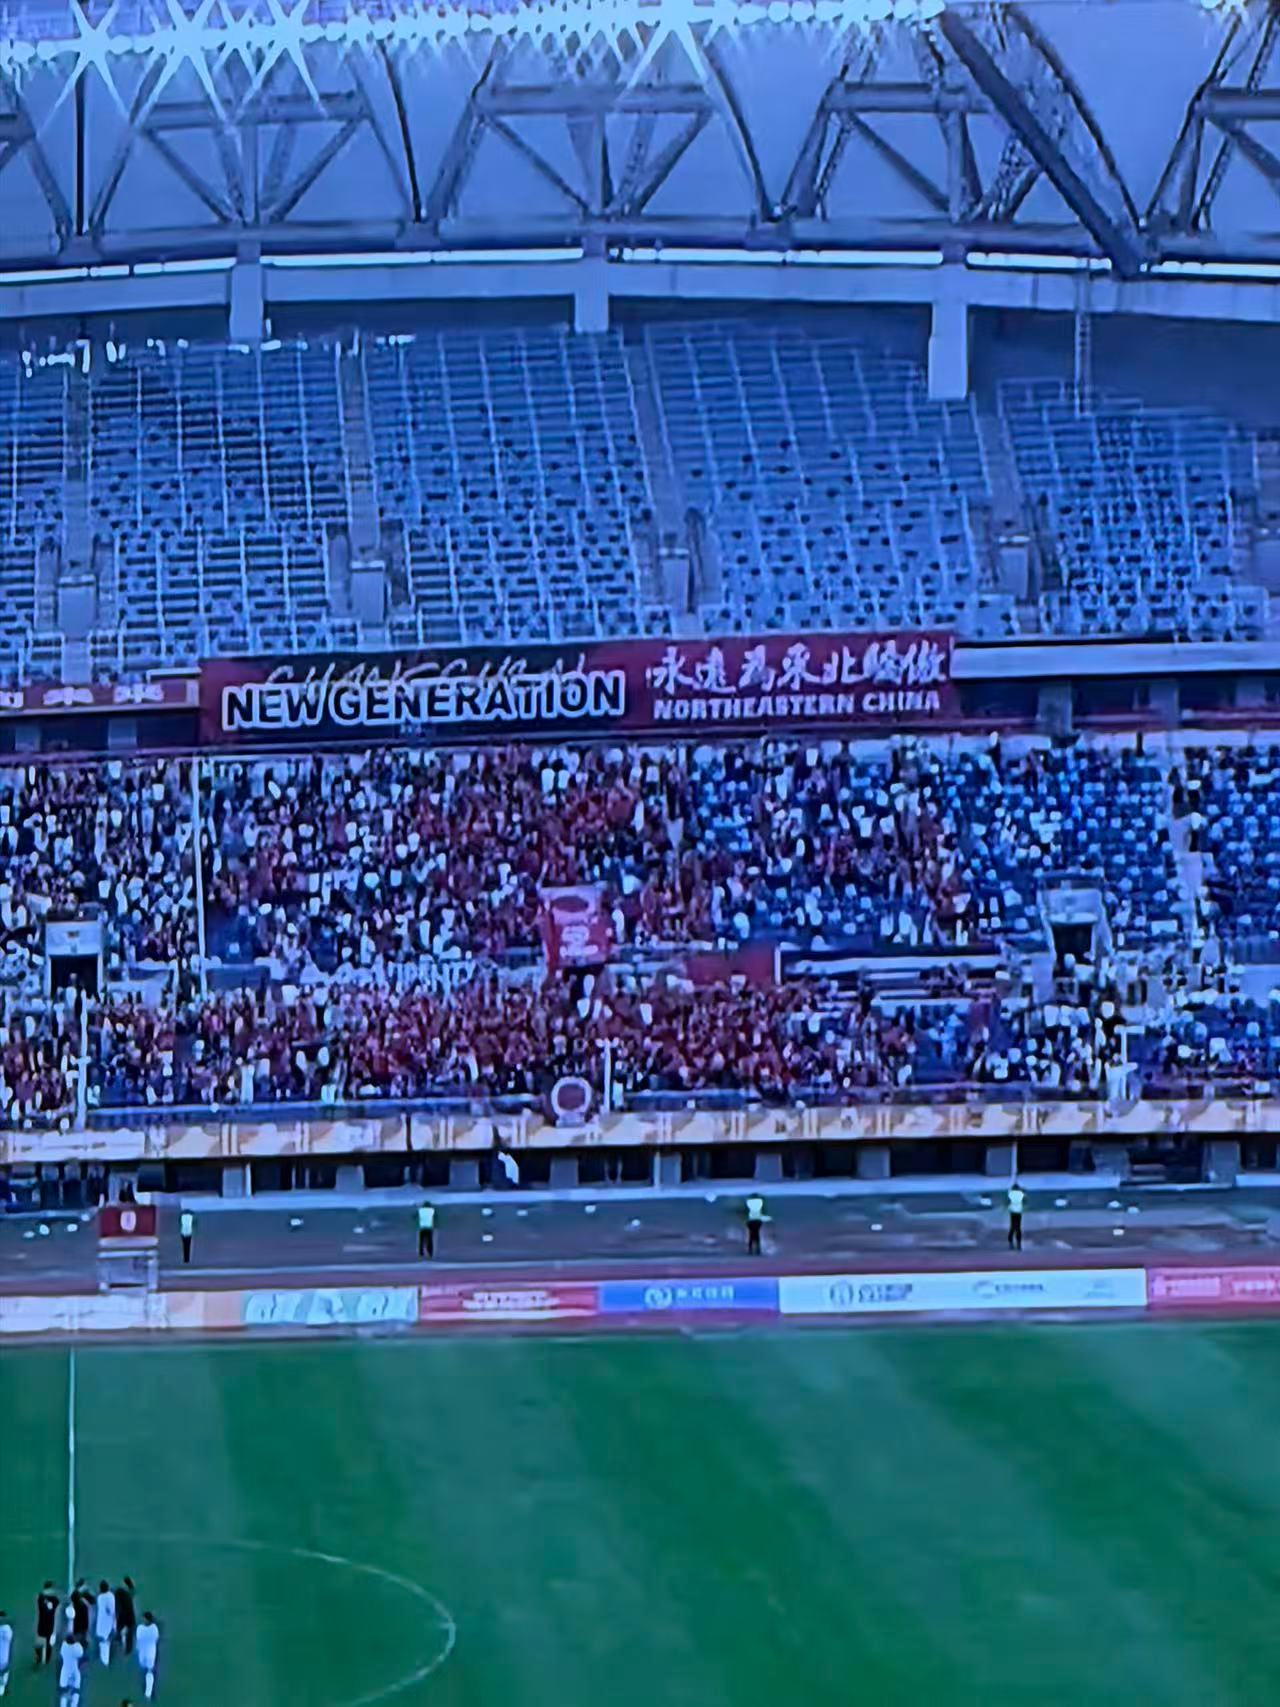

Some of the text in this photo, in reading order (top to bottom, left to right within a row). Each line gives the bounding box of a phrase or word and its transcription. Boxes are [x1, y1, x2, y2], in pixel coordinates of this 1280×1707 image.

[328, 671, 626, 726] GENERATION
[653, 690, 940, 720] NORTHEASTERN CHINA
